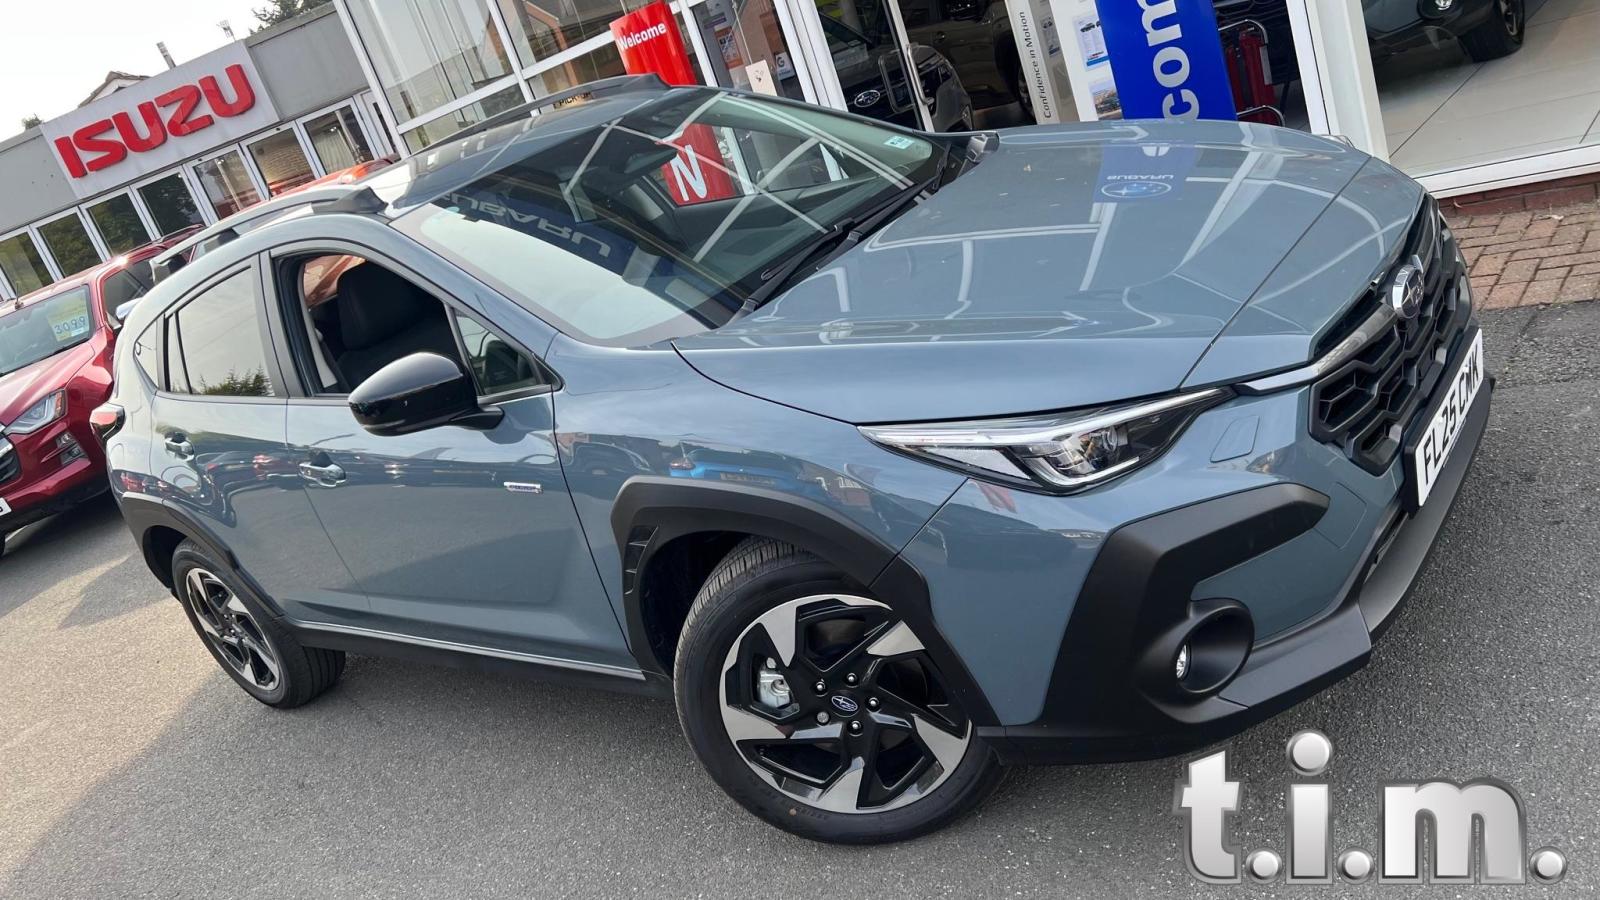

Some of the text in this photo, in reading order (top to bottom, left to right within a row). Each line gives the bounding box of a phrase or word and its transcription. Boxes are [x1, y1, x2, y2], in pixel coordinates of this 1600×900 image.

[618, 22, 667, 51] Welcome
[1019, 11, 1034, 48] Motion
[1032, 60, 1052, 119] Confidence
[54, 63, 256, 179] ISUZU
[1423, 389, 1457, 485] FL25
[1458, 343, 1479, 414] CMK
